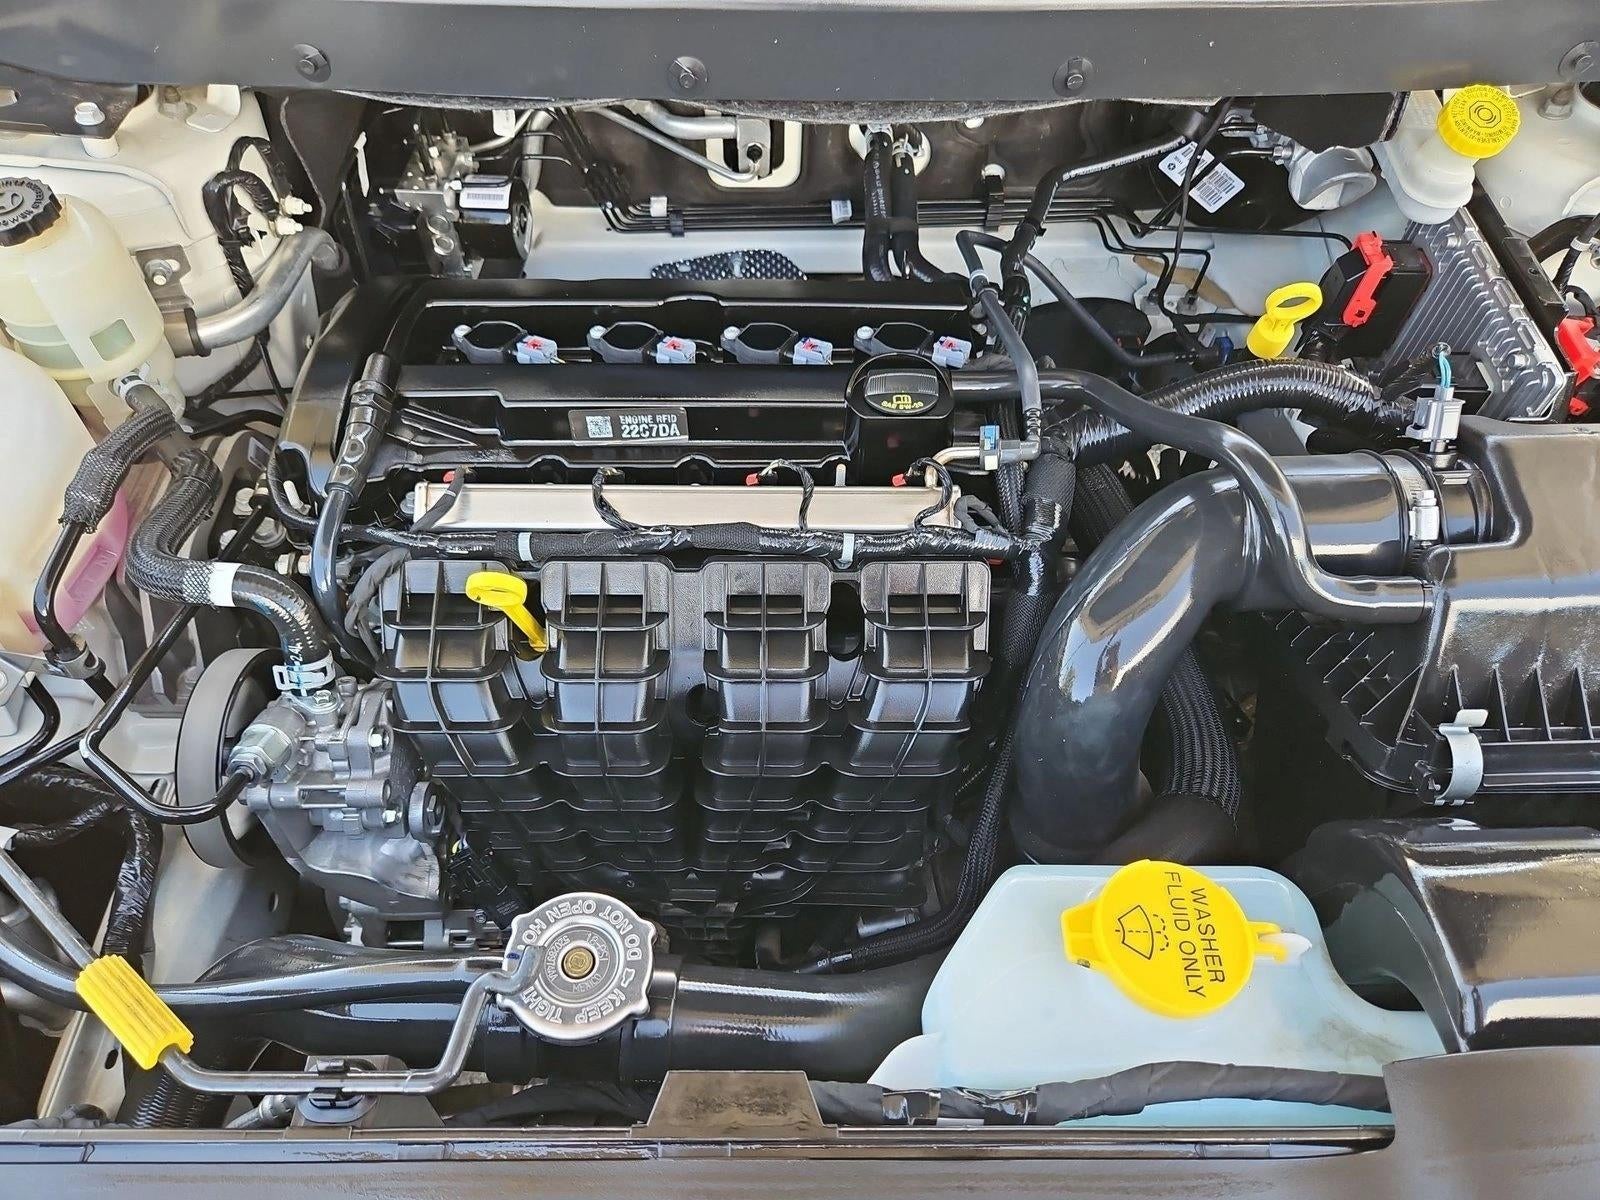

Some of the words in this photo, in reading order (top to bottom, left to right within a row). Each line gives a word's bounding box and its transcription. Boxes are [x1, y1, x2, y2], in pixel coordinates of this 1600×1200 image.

[619, 415, 654, 425] ENGINE
[656, 414, 678, 423] RFID
[546, 899, 597, 923] OPEN
[599, 905, 634, 934] NOT
[624, 934, 643, 961] DO
[1164, 871, 1191, 931] FLUID
[1178, 940, 1206, 998] ONLY
[1190, 887, 1226, 983] WASHER
[521, 985, 563, 1024] TIGHT
[574, 988, 626, 1024] KEEP
